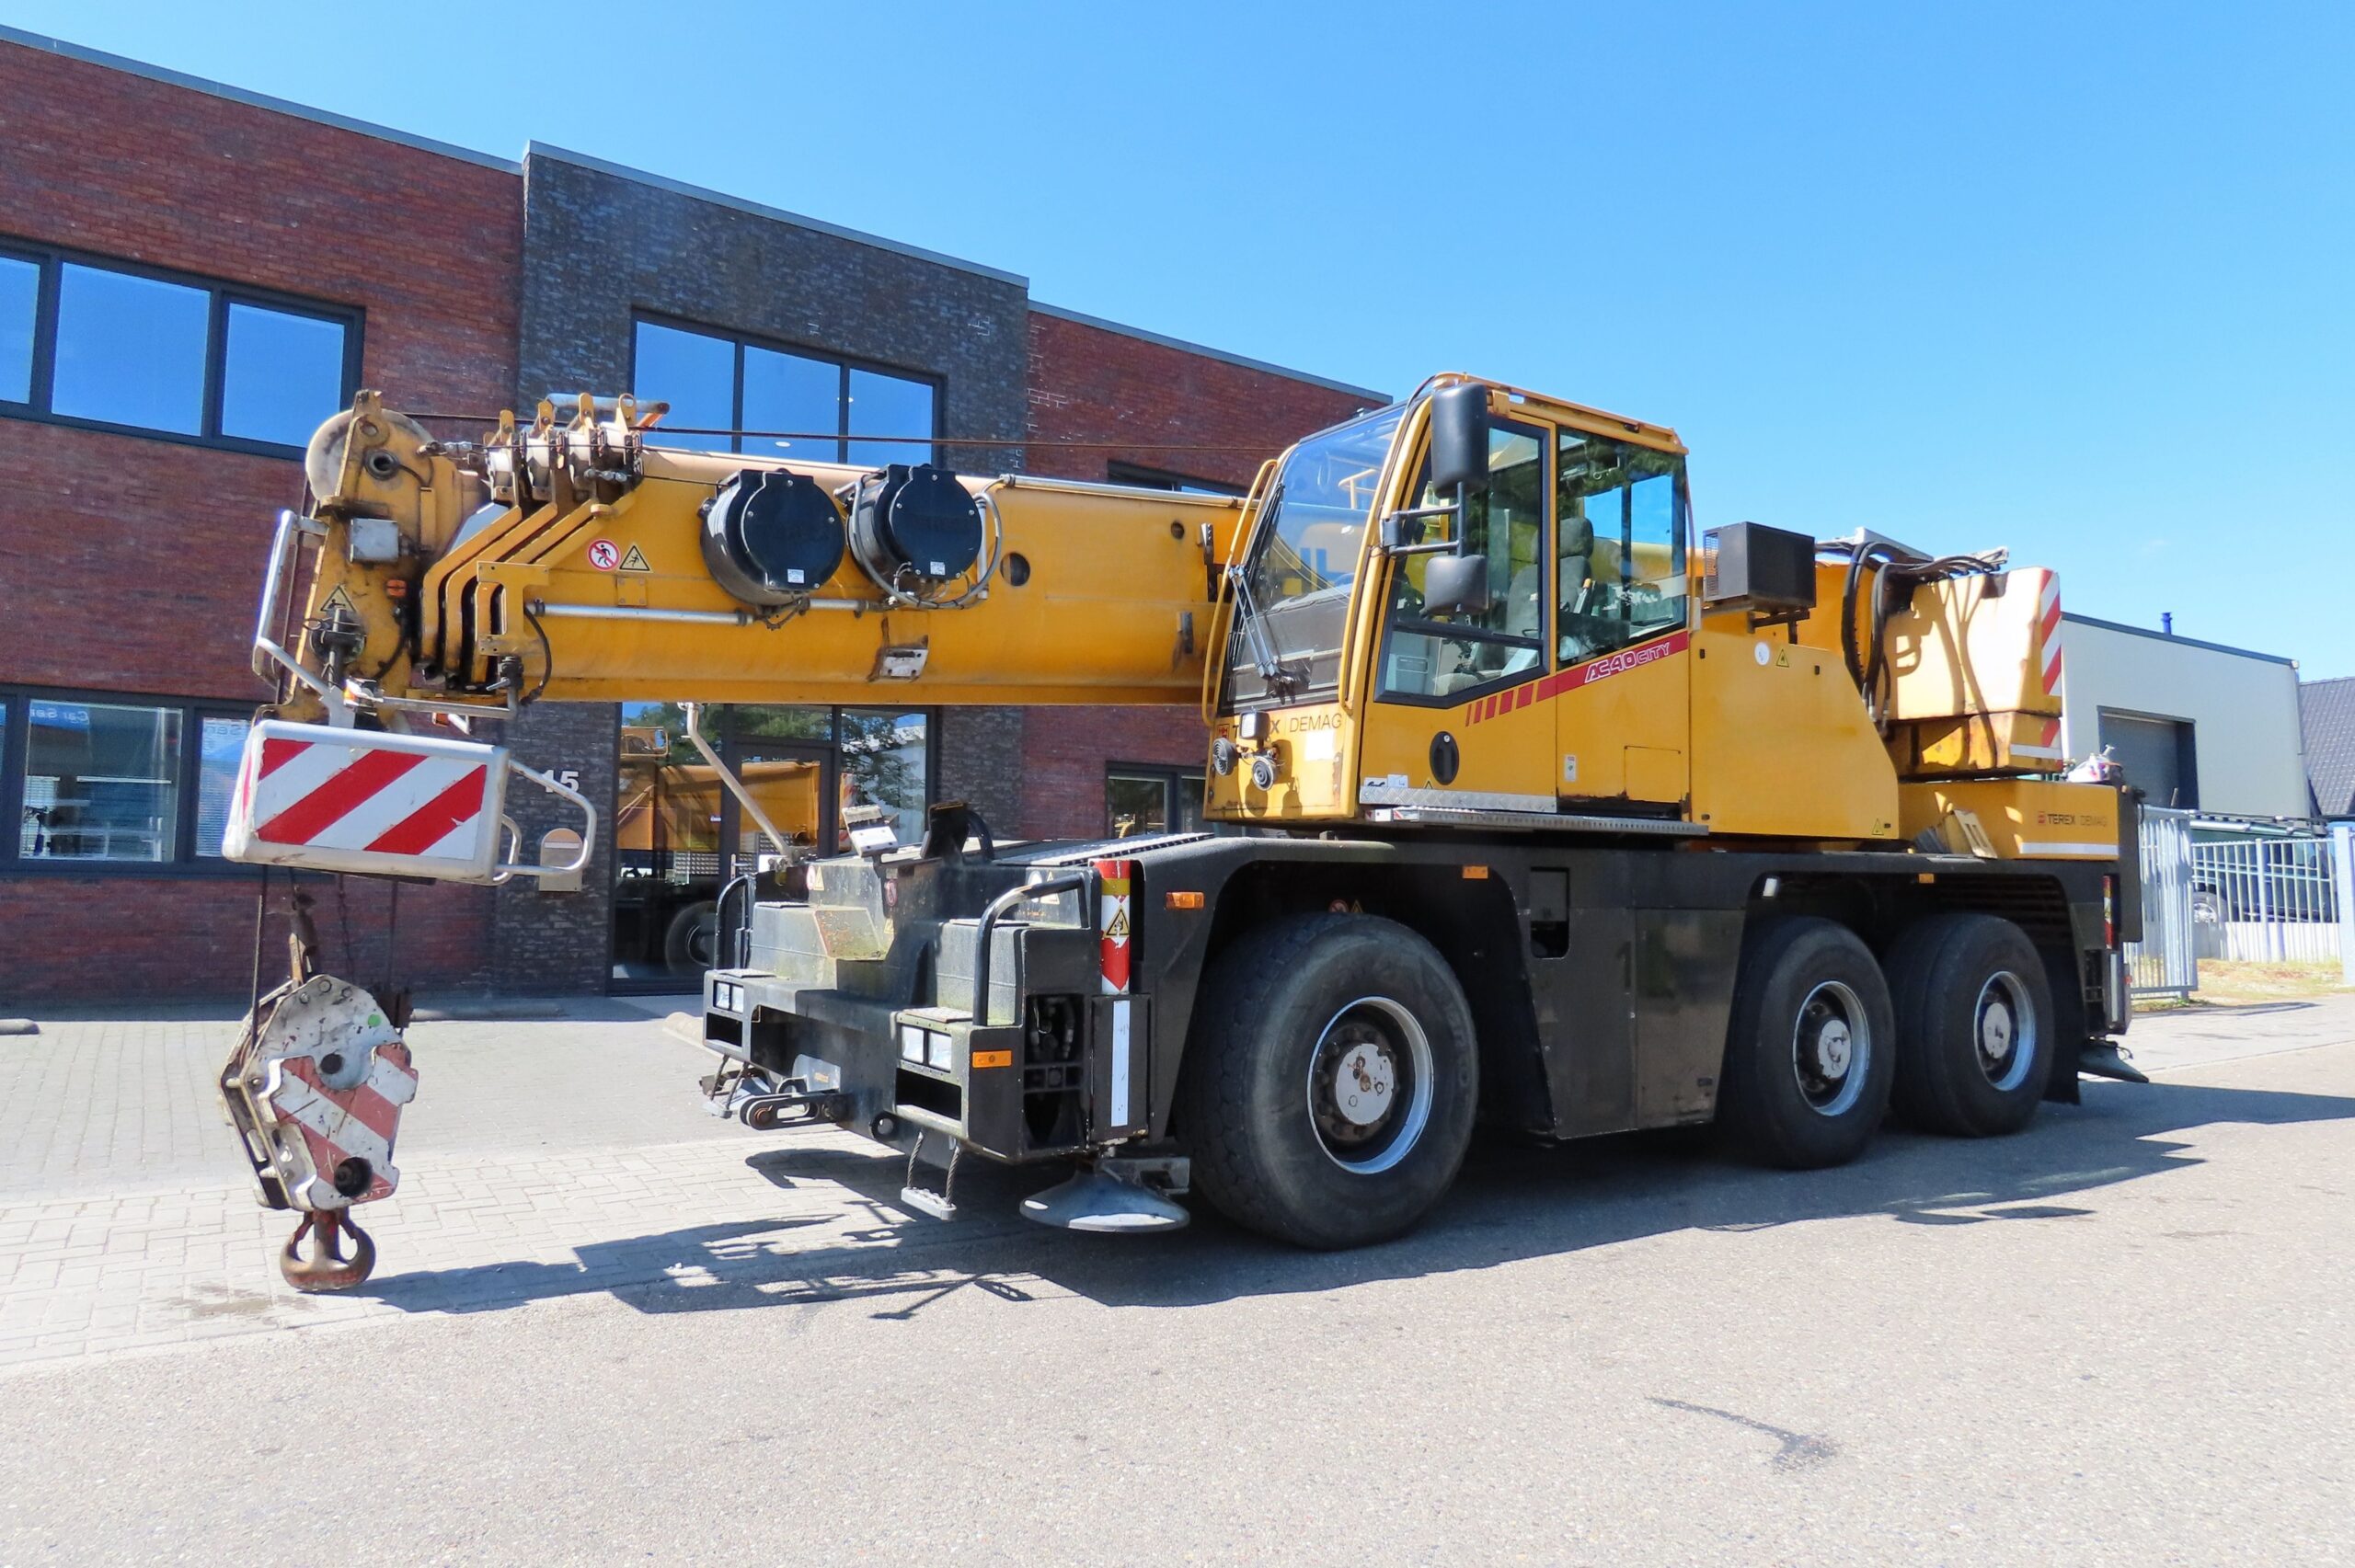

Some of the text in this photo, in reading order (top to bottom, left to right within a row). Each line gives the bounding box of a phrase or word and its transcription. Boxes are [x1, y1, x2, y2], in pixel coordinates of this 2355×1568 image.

[1290, 713, 1342, 733] DEMAG
[542, 769, 580, 793] 15
[2047, 813, 2075, 826] TEREX
